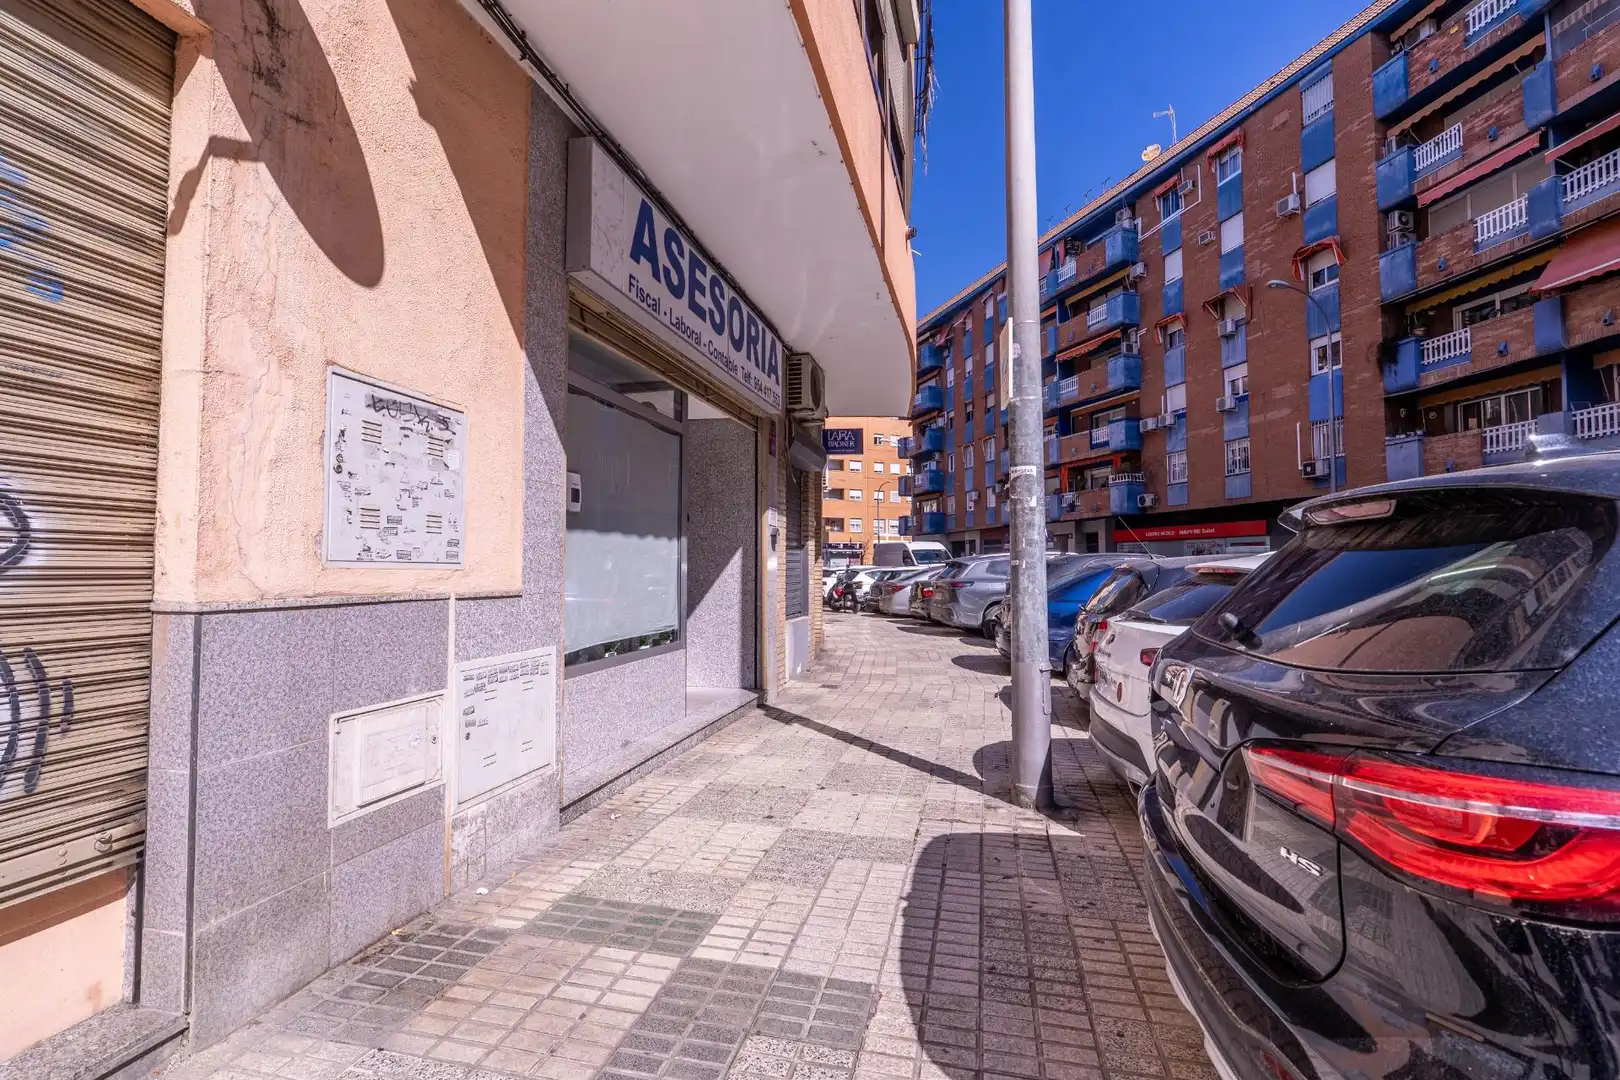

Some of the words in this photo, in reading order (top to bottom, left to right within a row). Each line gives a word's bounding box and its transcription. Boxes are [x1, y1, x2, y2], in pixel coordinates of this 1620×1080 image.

[628, 273, 661, 316] Fiscal
[669, 307, 701, 346] Laboral
[707, 339, 739, 376] Contable
[629, 197, 780, 386] ASESORIA
[1280, 846, 1321, 877] HS
